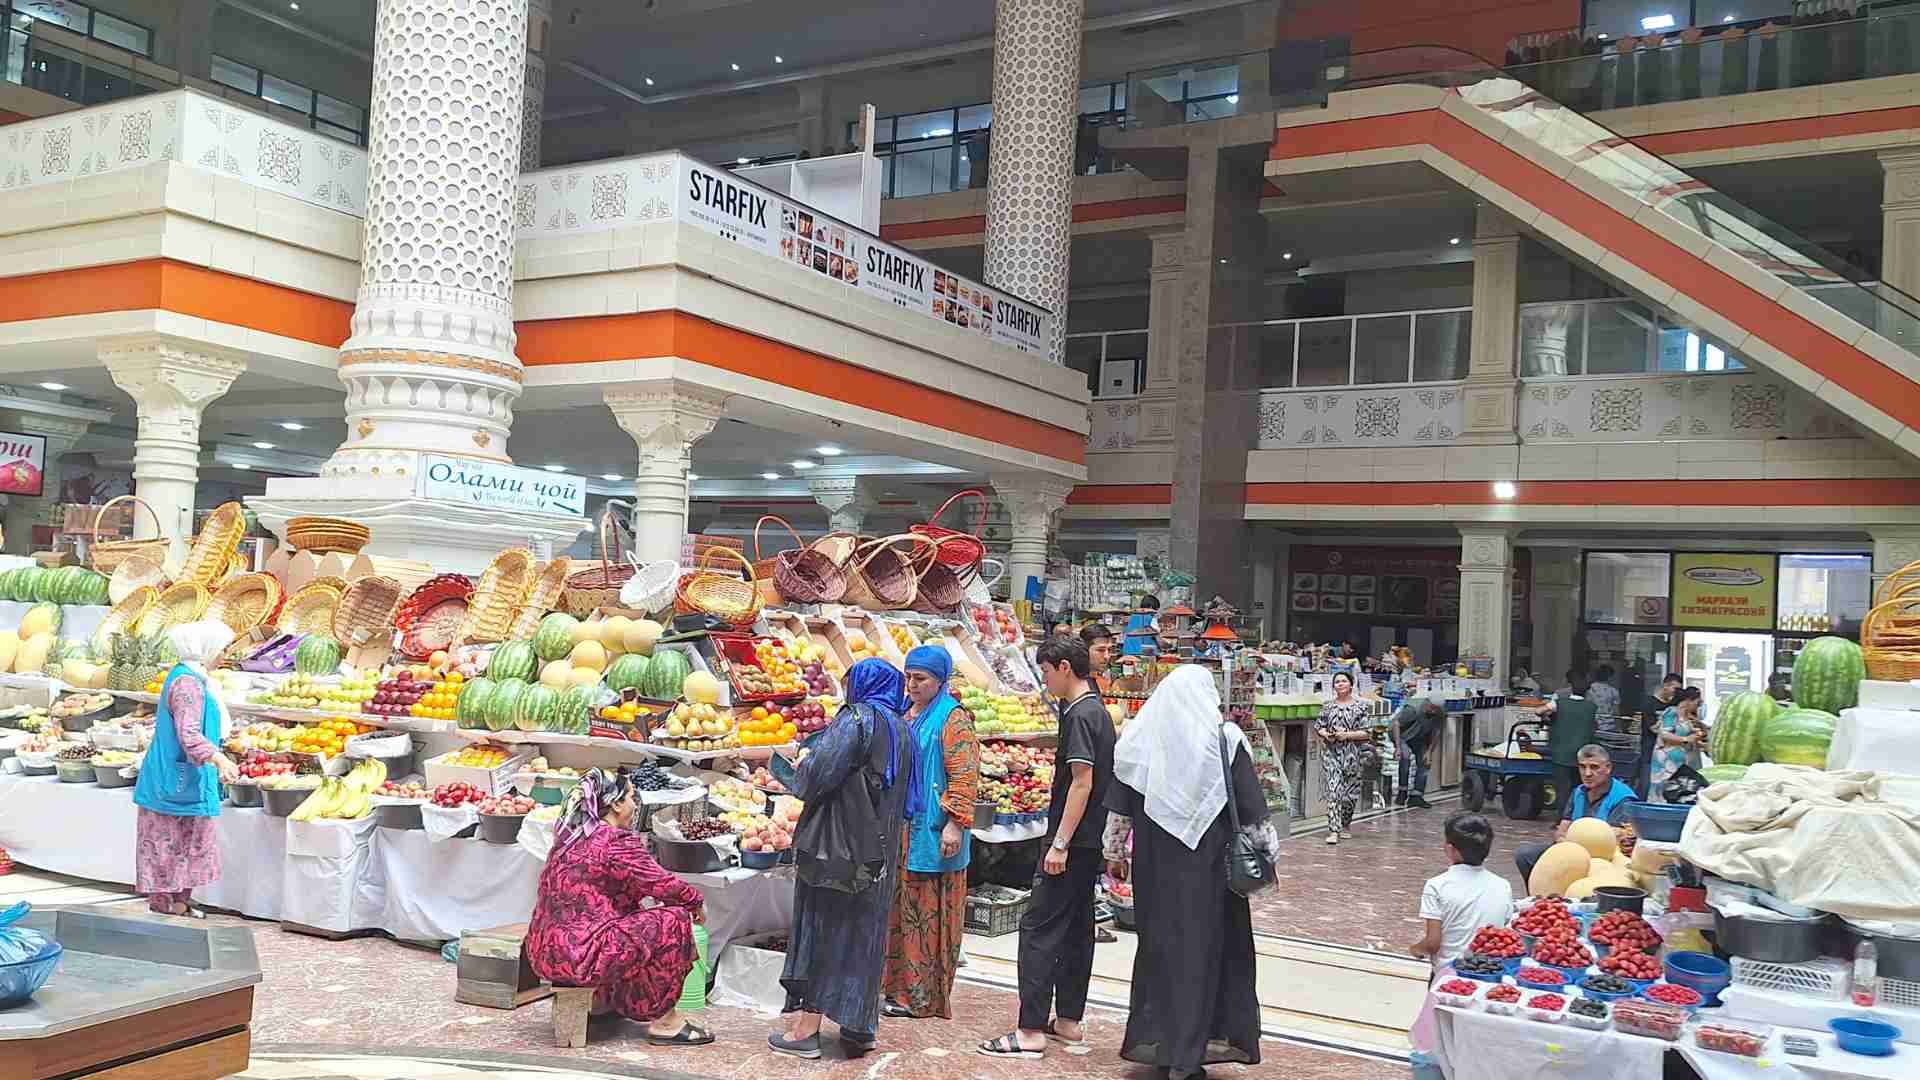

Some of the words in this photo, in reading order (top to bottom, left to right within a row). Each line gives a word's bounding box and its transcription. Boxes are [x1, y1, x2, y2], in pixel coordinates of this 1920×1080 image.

[690, 169, 768, 229] STARFIX
[867, 246, 925, 293] STARFIX
[997, 300, 1041, 340] STARFIX
[429, 463, 525, 493] Олами
[534, 482, 578, 500] чой
